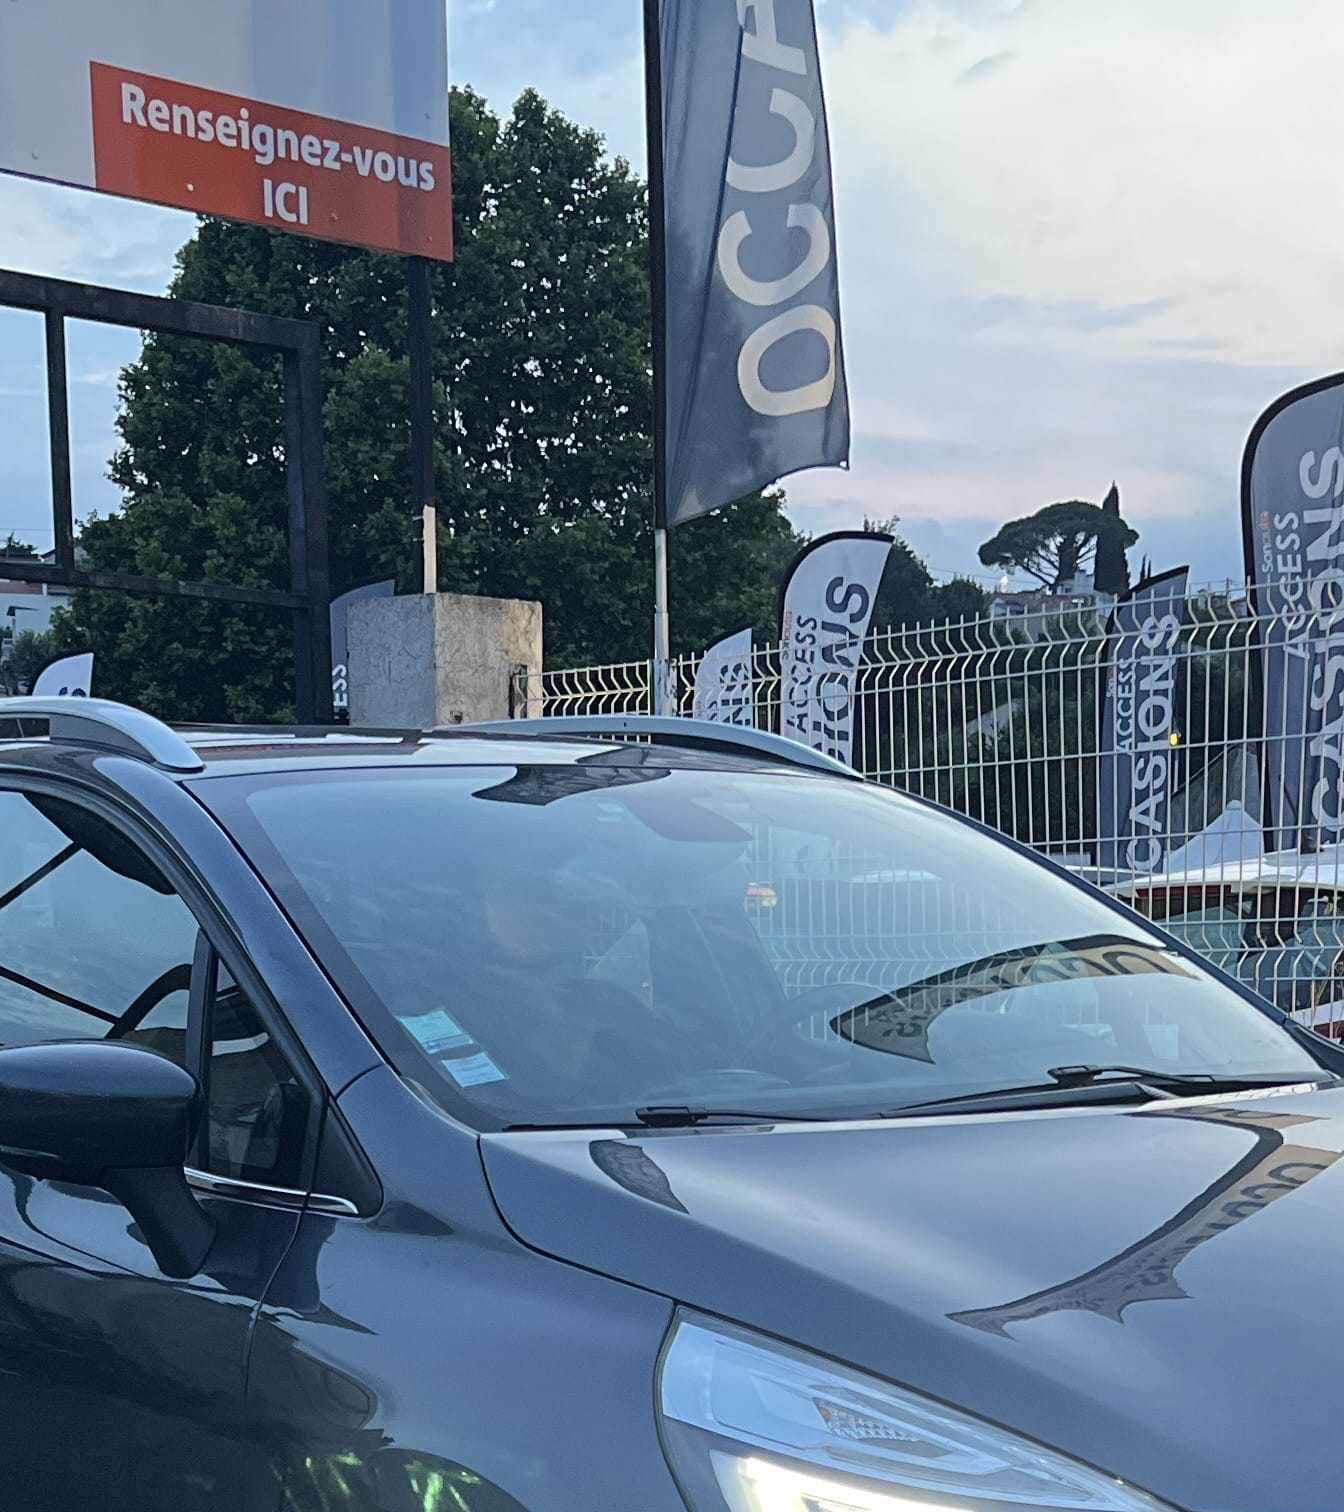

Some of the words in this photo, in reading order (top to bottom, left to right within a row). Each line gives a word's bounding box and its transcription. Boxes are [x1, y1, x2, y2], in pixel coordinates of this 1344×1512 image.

[120, 81, 436, 192] Renseignez-vous
[262, 178, 309, 225] ICI
[1273, 510, 1310, 660] ACCESS
[332, 663, 348, 708] ESS
[786, 615, 818, 735] ACCESS
[1116, 657, 1136, 755] ACCESS
